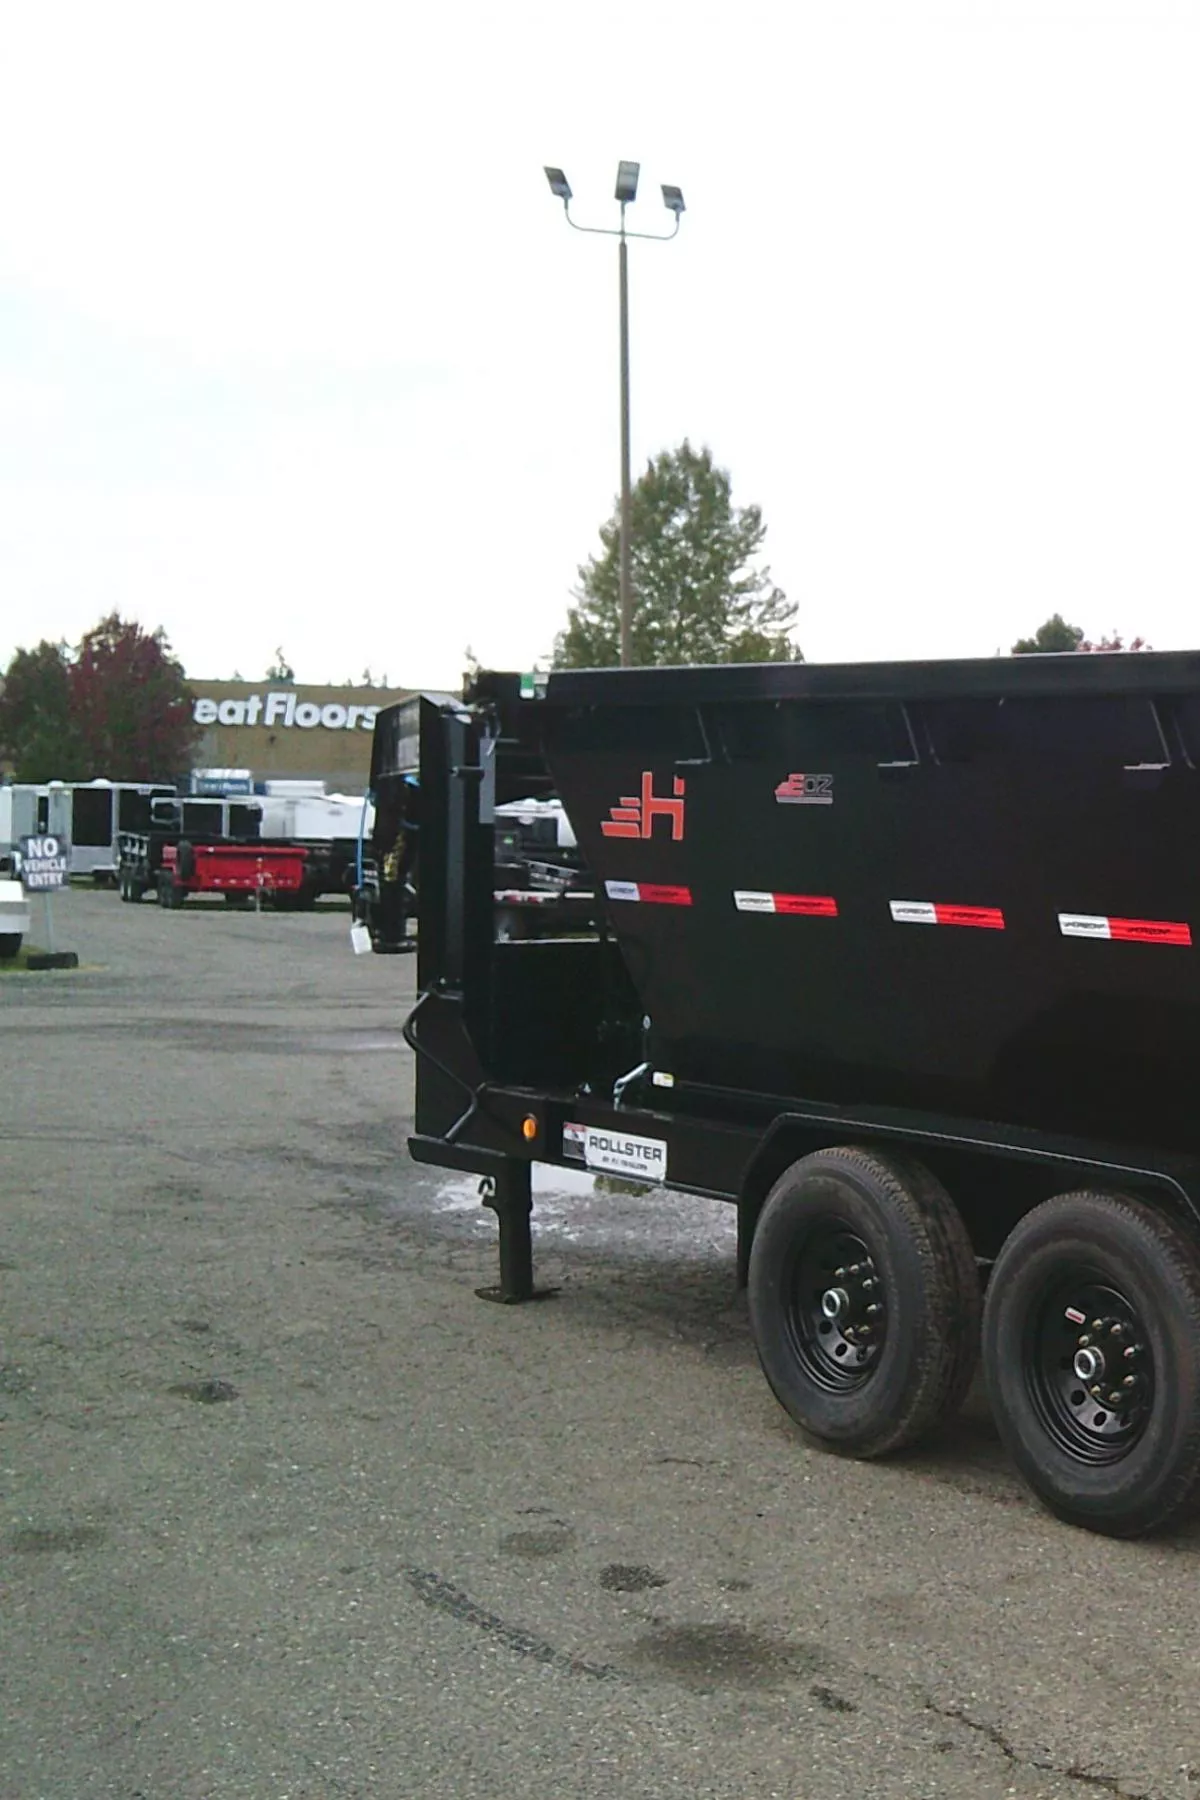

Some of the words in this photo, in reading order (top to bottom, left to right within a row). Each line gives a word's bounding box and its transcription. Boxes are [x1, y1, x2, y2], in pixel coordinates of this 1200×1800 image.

[192, 694, 262, 726] eat
[264, 692, 378, 730] Floors
[27, 837, 59, 858] NO
[28, 872, 63, 887] ENTRY
[589, 1136, 662, 1161] ROLLSTER
